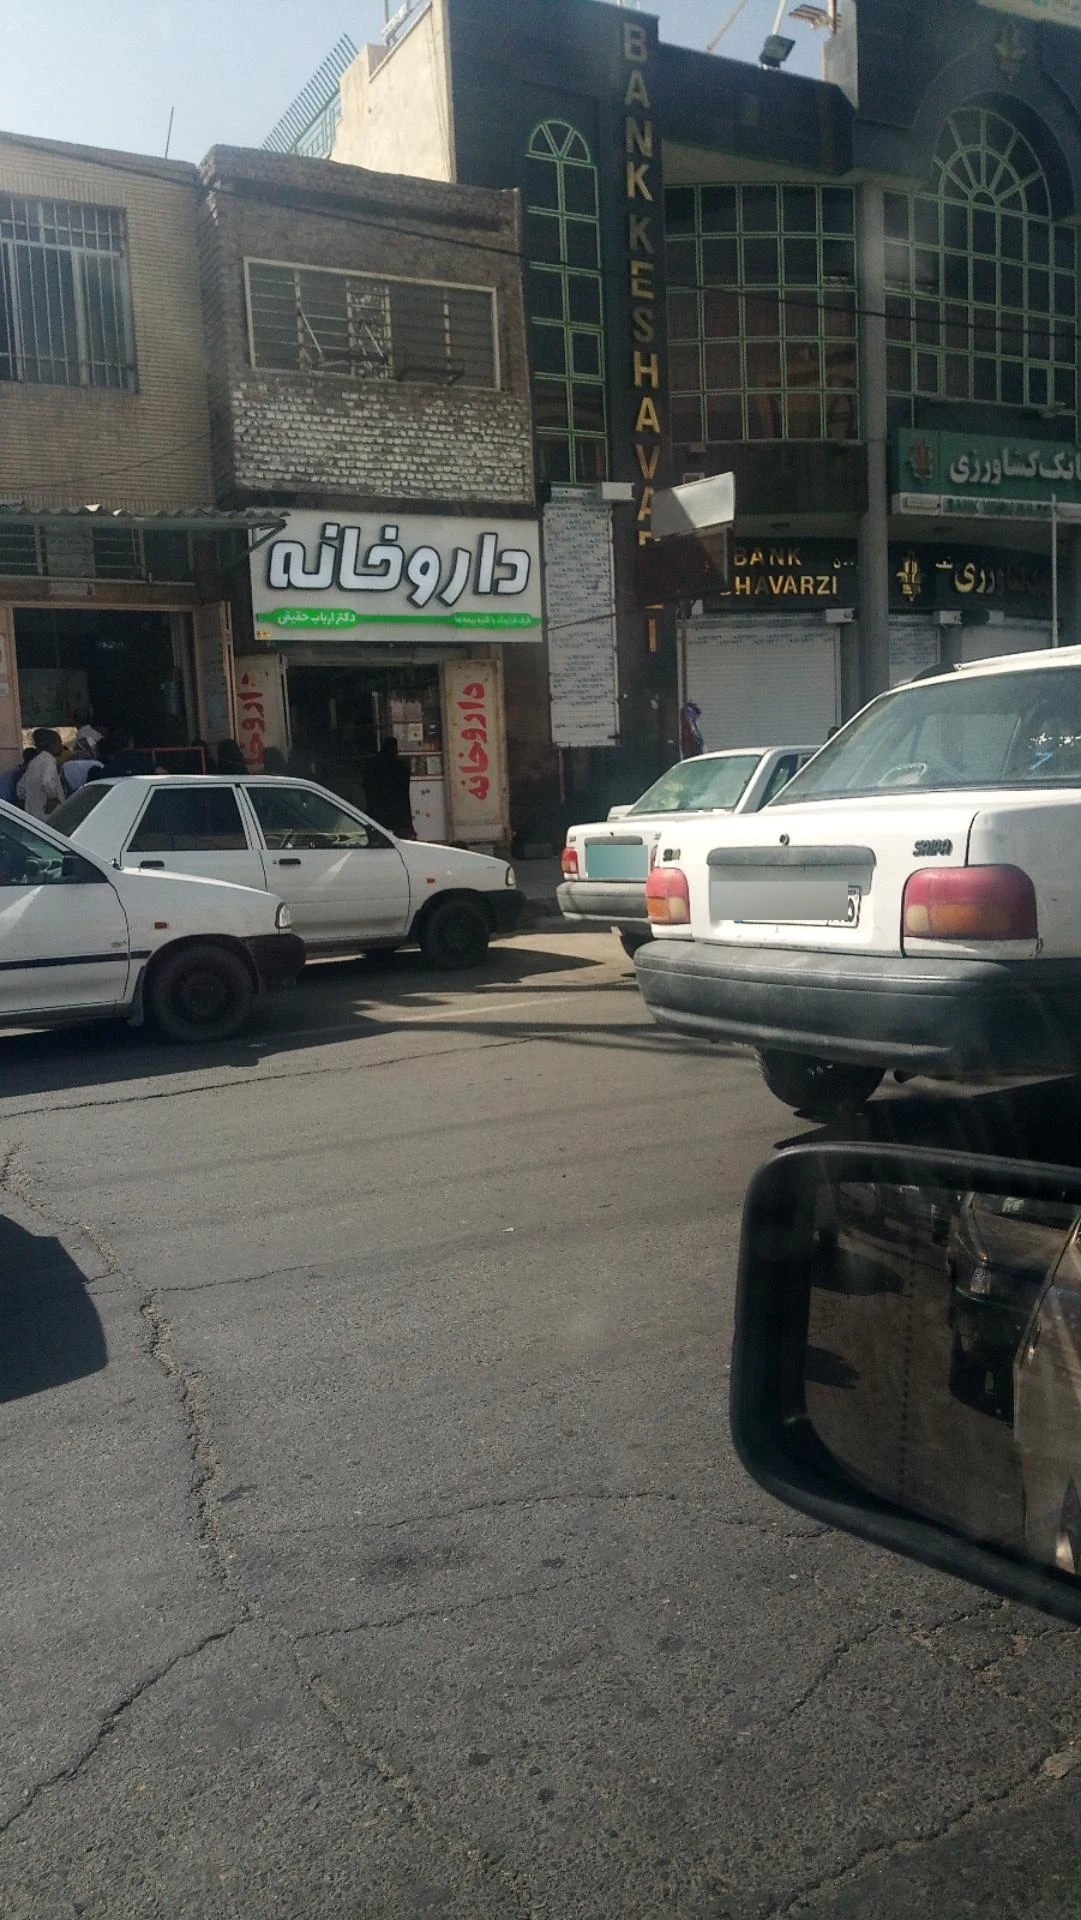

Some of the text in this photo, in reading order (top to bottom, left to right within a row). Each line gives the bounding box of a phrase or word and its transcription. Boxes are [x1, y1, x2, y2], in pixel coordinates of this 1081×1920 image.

[621, 22, 662, 653] BANK KESHAVAI
[950, 447, 1081, 483] انک کشاورزی
[268, 522, 532, 608] داروخانه
[733, 547, 802, 567] BANK
[720, 575, 838, 596] HAVARZI
[277, 610, 356, 625] دکتر ارباب حقیقی
[456, 682, 490, 801] داروخانه
[912, 838, 954, 857] SAIPA
